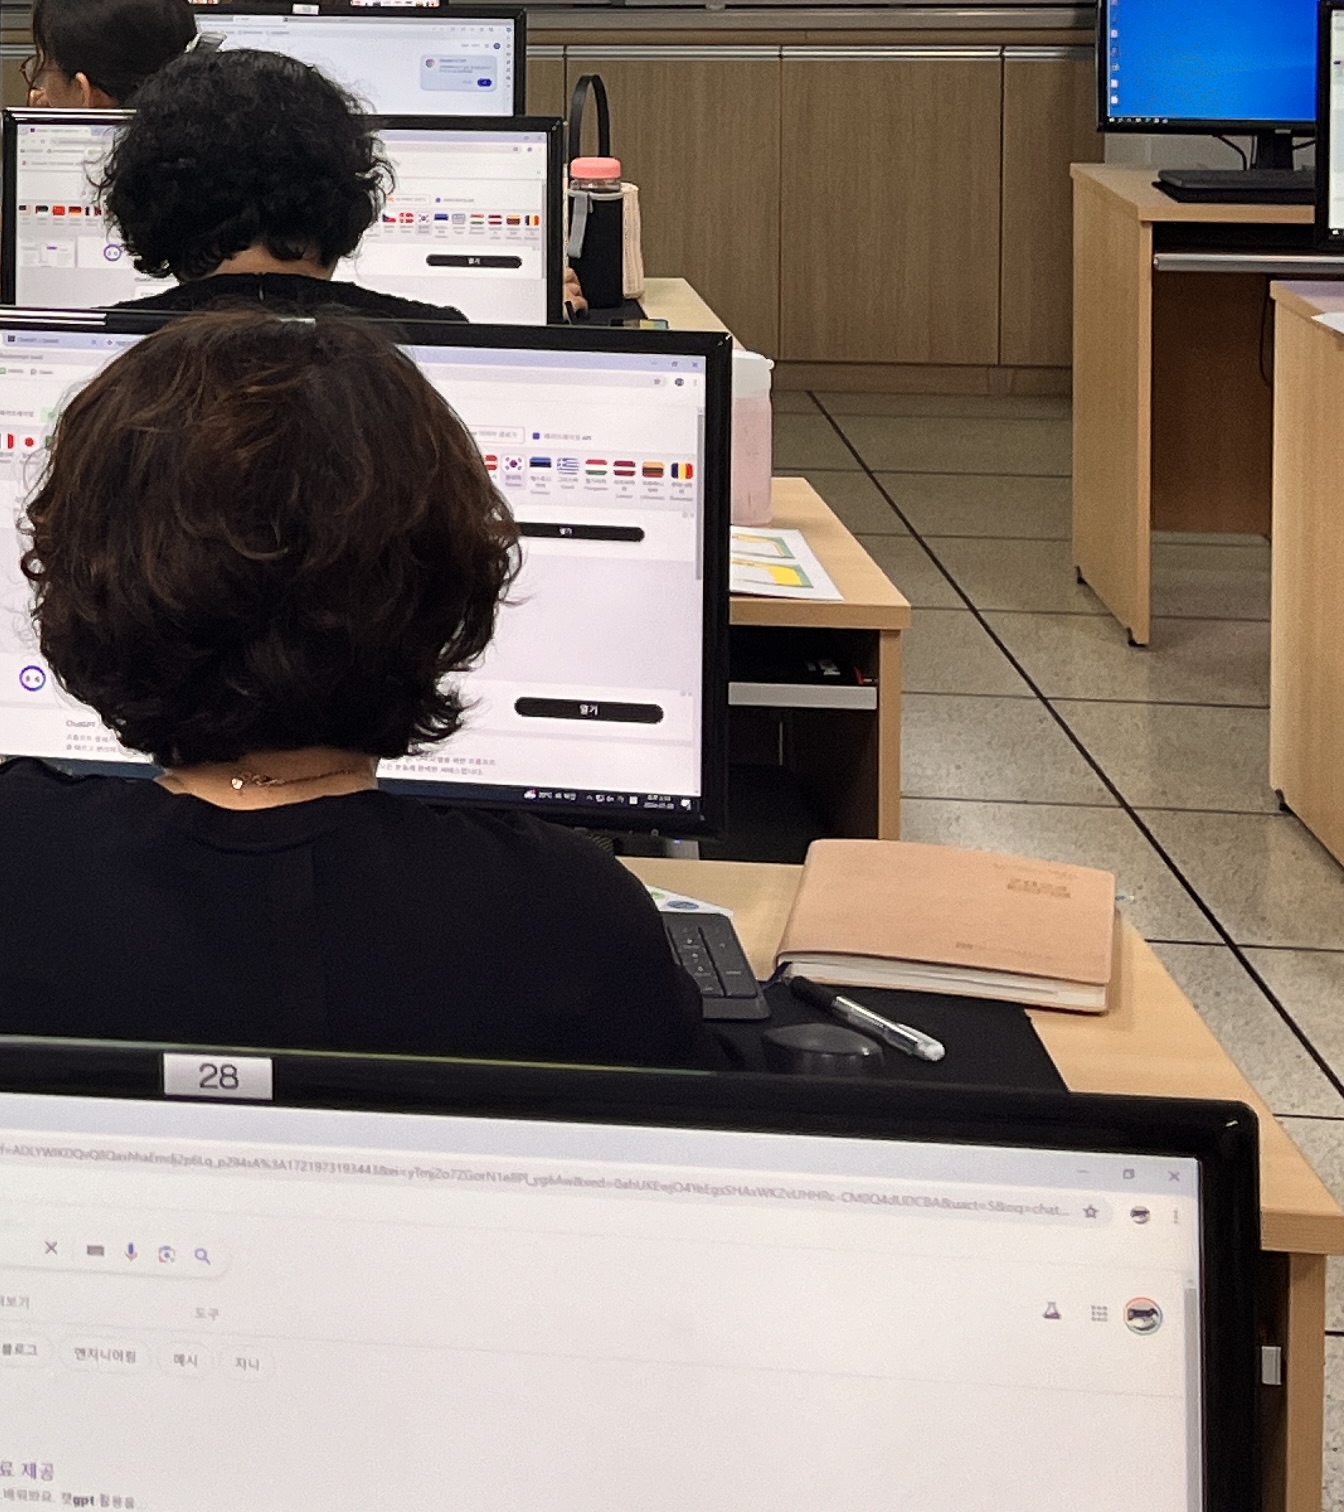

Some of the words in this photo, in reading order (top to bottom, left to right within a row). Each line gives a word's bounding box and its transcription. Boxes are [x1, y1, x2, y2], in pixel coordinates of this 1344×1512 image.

[198, 1062, 240, 1092] 28
[195, 1307, 220, 1321] 도구
[2, 1343, 38, 1357] 블로그
[73, 1347, 137, 1364] 엔지니어링
[235, 1357, 261, 1372] 지니
[21, 1462, 54, 1482] 제공
